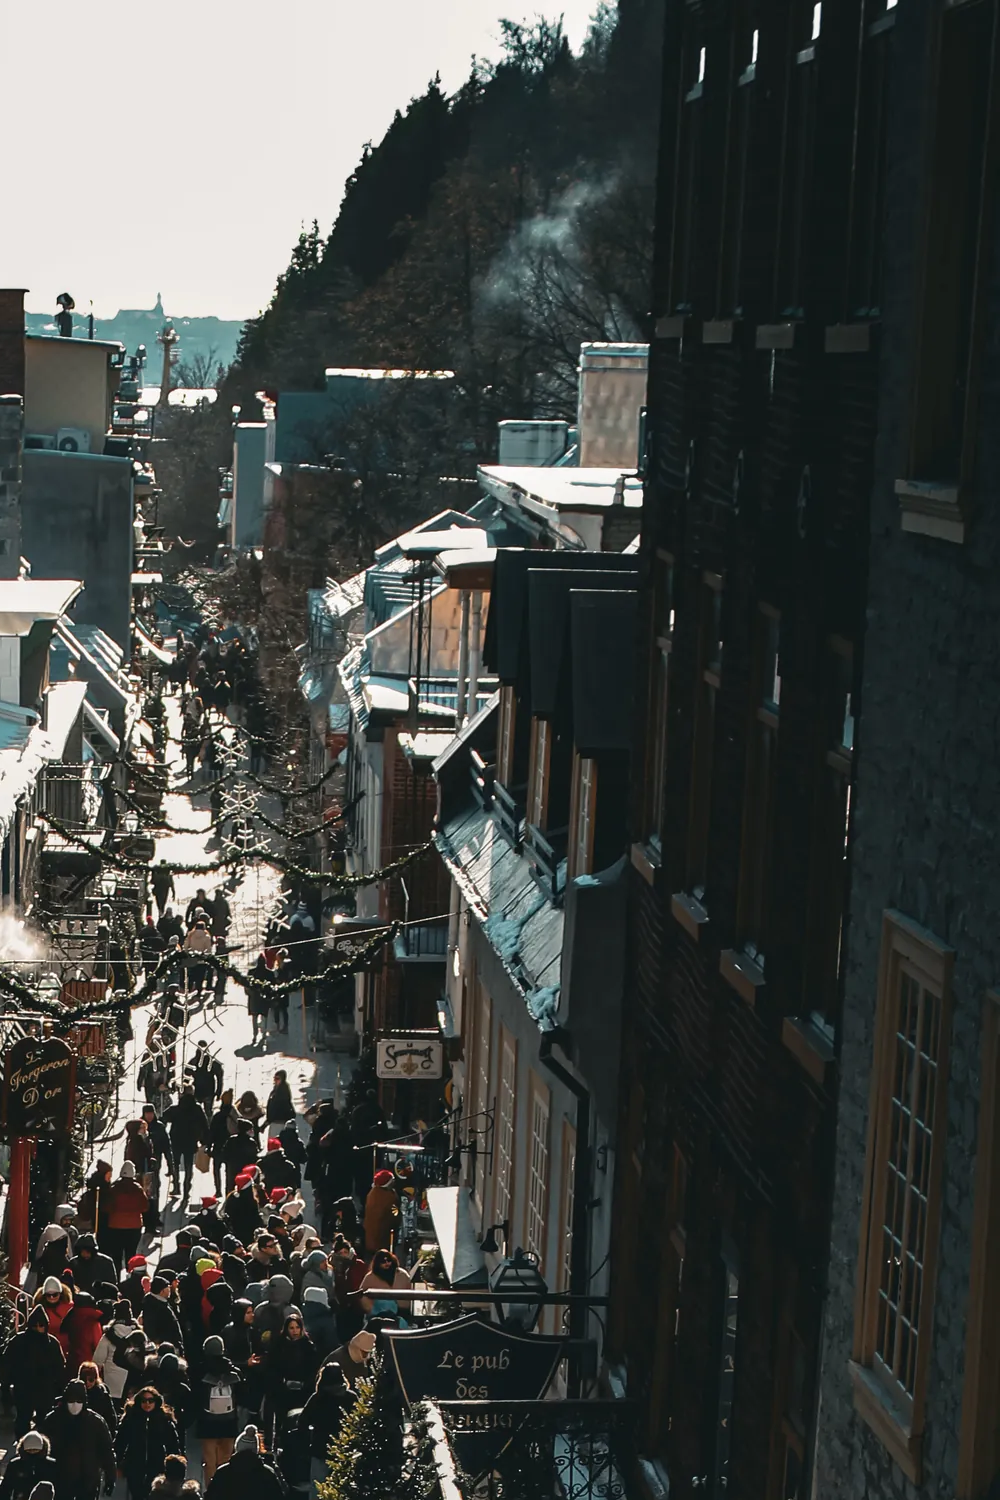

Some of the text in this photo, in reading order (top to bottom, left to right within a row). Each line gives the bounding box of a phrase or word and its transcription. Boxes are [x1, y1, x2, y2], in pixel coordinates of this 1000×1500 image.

[10, 1059, 70, 1092] Forgeron
[437, 1349, 510, 1374] Le pub
[455, 1378, 489, 1399] des
